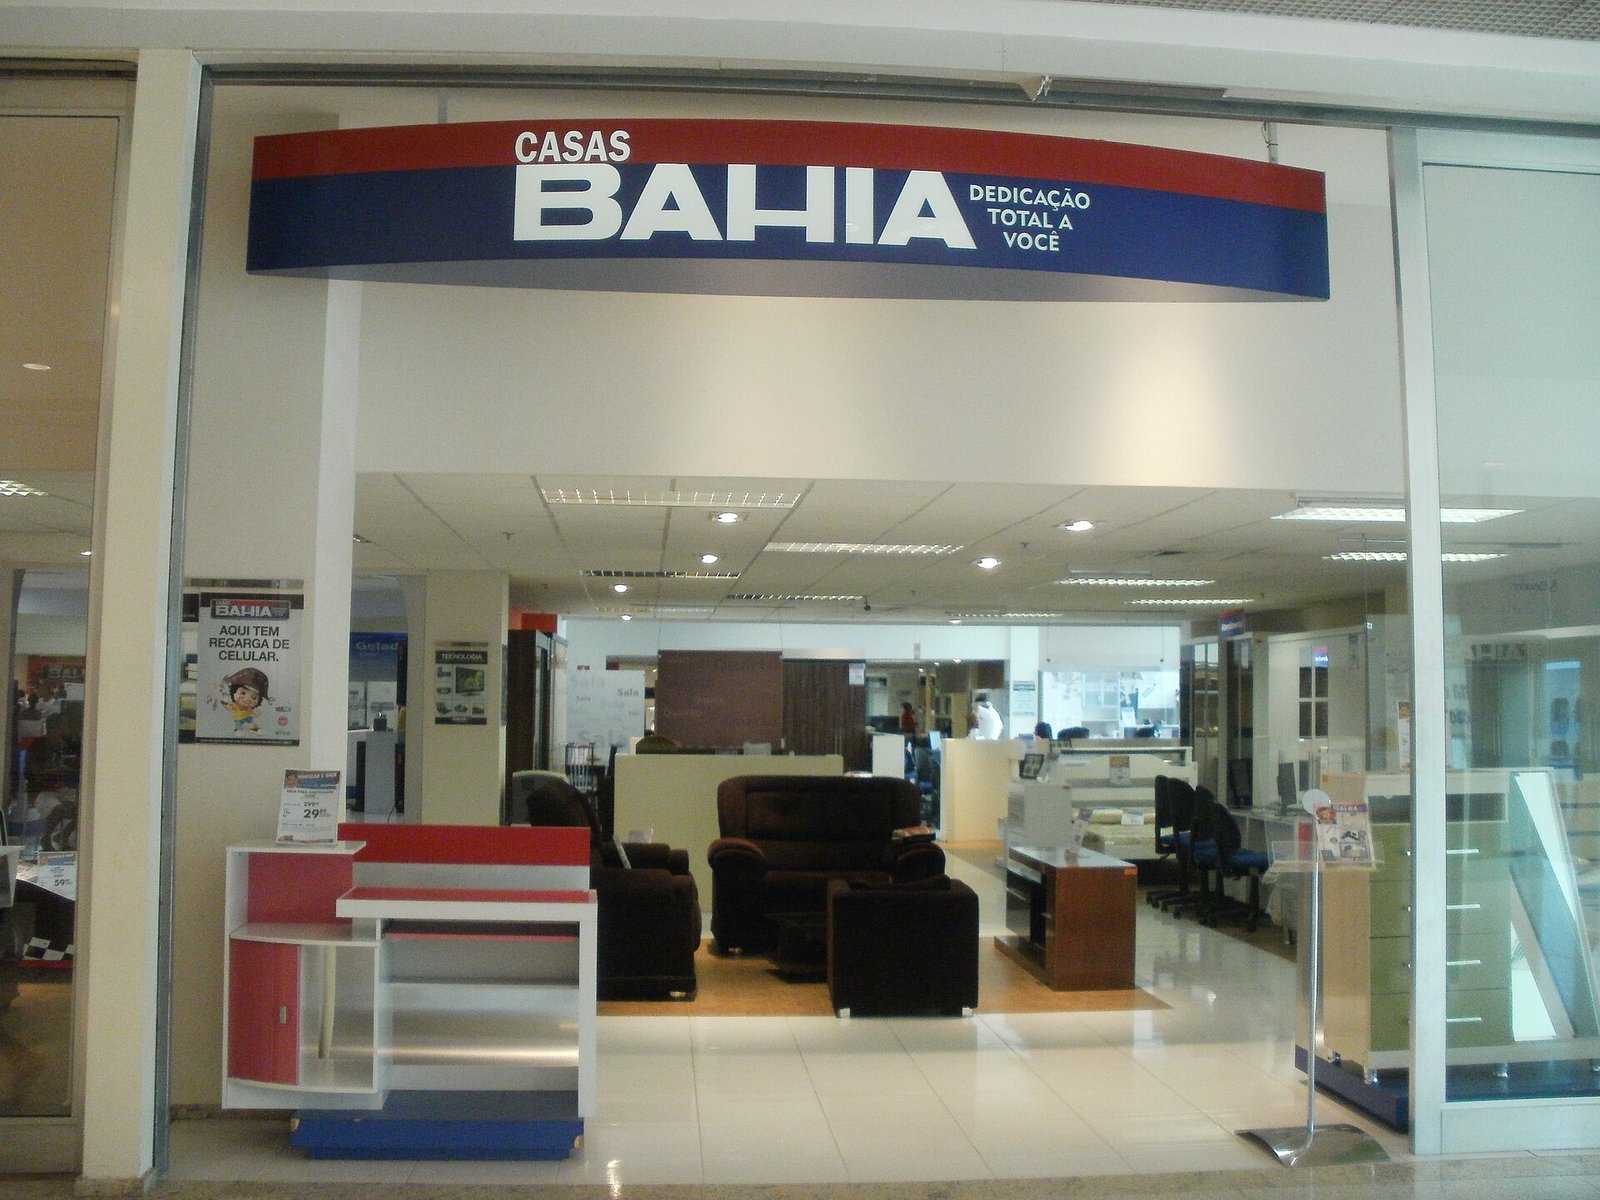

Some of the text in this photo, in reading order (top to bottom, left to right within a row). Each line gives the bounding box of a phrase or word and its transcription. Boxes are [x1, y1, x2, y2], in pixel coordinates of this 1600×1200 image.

[514, 130, 631, 163] CASAS
[969, 184, 1091, 211] DEDICAÇÃO
[513, 163, 977, 250] BAHIA
[987, 207, 1074, 231] TOTAL A
[1003, 230, 1060, 252] VOCÊ
[215, 605, 272, 617] BAHIA
[219, 625, 280, 637] AQUI TEM
[209, 637, 290, 649] RECARGA DE
[218, 650, 279, 662] CELULAR.
[617, 687, 639, 697] Sala
